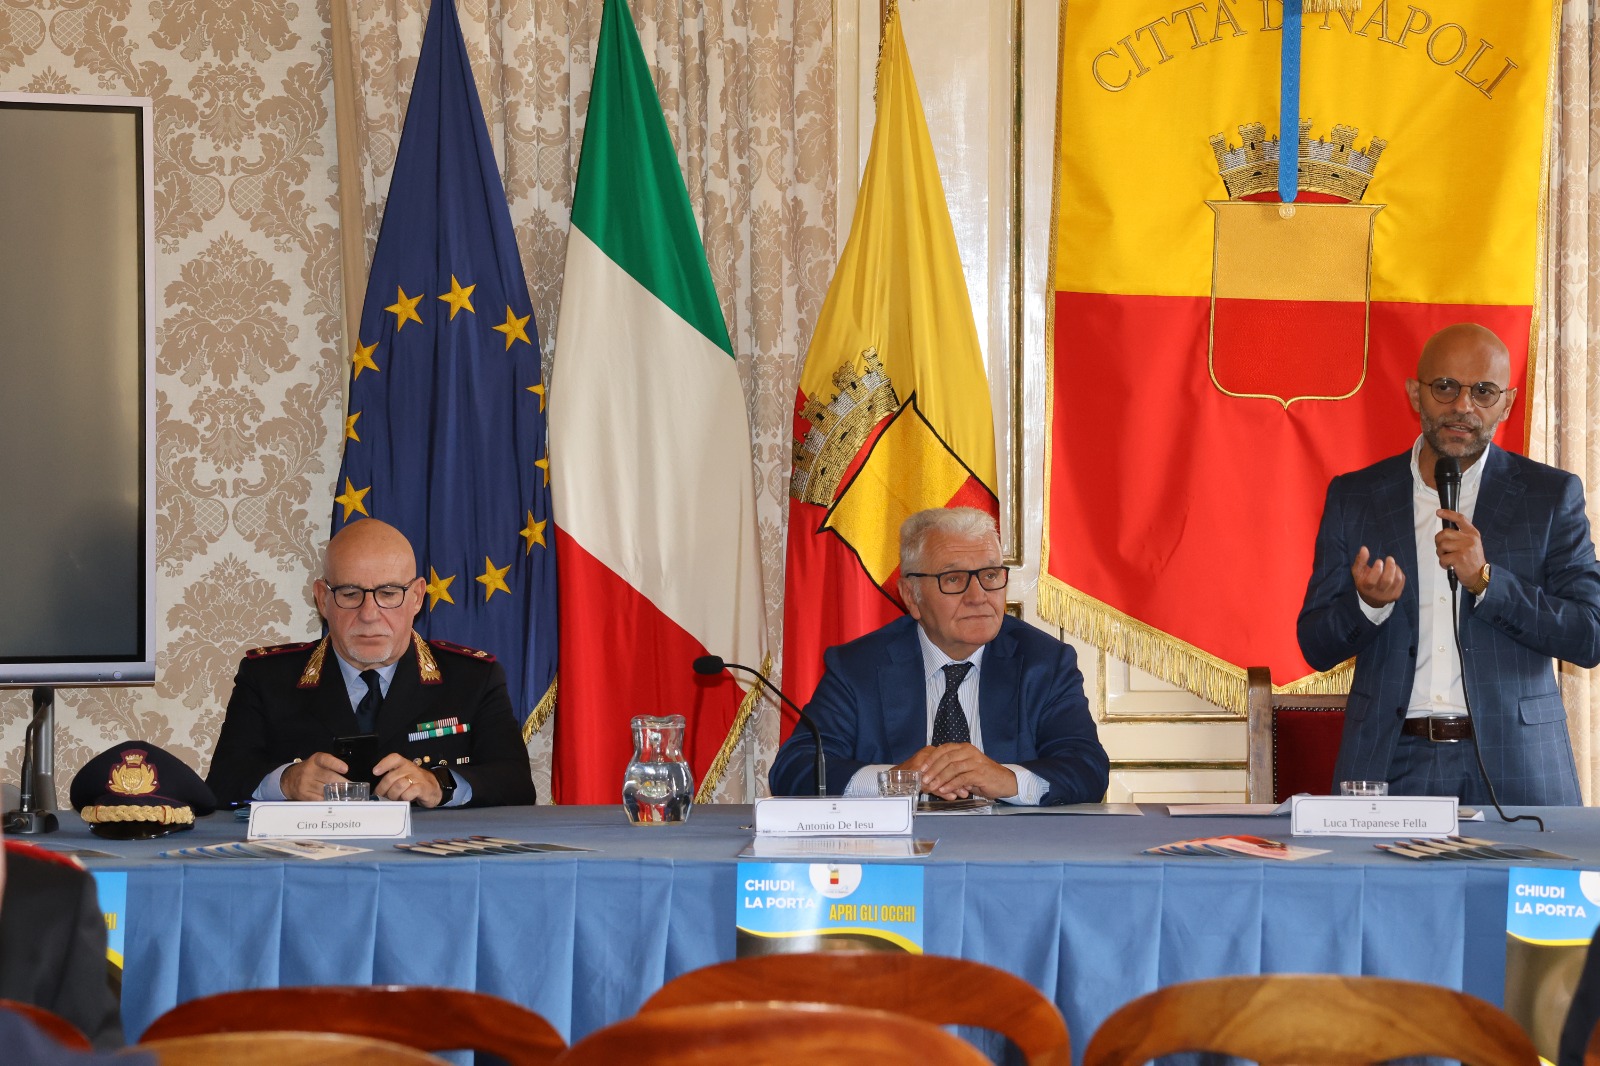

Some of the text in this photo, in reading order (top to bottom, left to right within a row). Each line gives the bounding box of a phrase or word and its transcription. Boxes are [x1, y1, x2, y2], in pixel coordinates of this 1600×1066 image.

[297, 820, 361, 831] Ciro Esposito
[796, 820, 874, 831] Antonio De Iesu
[1323, 818, 1428, 830] Luca Trapanese Fella
[744, 879, 795, 891] CHIUDI
[1515, 884, 1565, 898] CHIUDI
[745, 896, 816, 909] LA PORTA
[829, 903, 916, 923] APRI GLI OCCHI
[1515, 902, 1587, 918] LA PORTA
